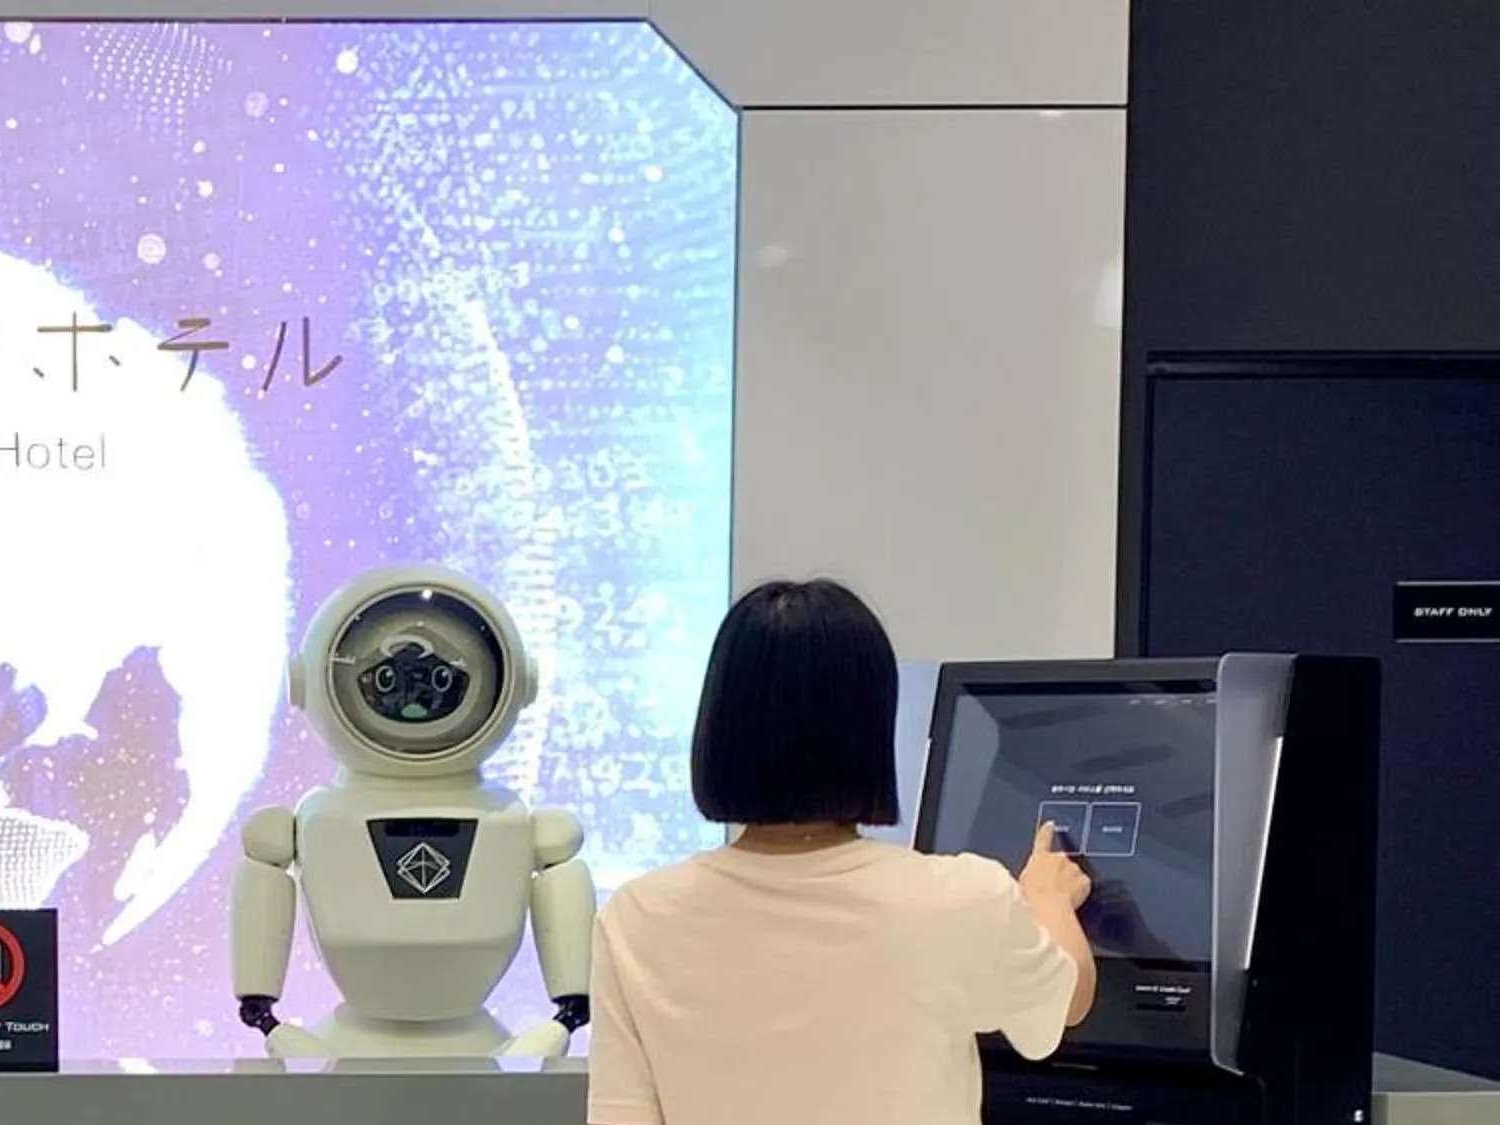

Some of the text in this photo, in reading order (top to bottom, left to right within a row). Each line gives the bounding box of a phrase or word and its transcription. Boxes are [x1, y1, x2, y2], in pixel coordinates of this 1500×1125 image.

[1413, 607, 1493, 617] STAFF ONLY
[7, 1021, 50, 1033] TOUCH
